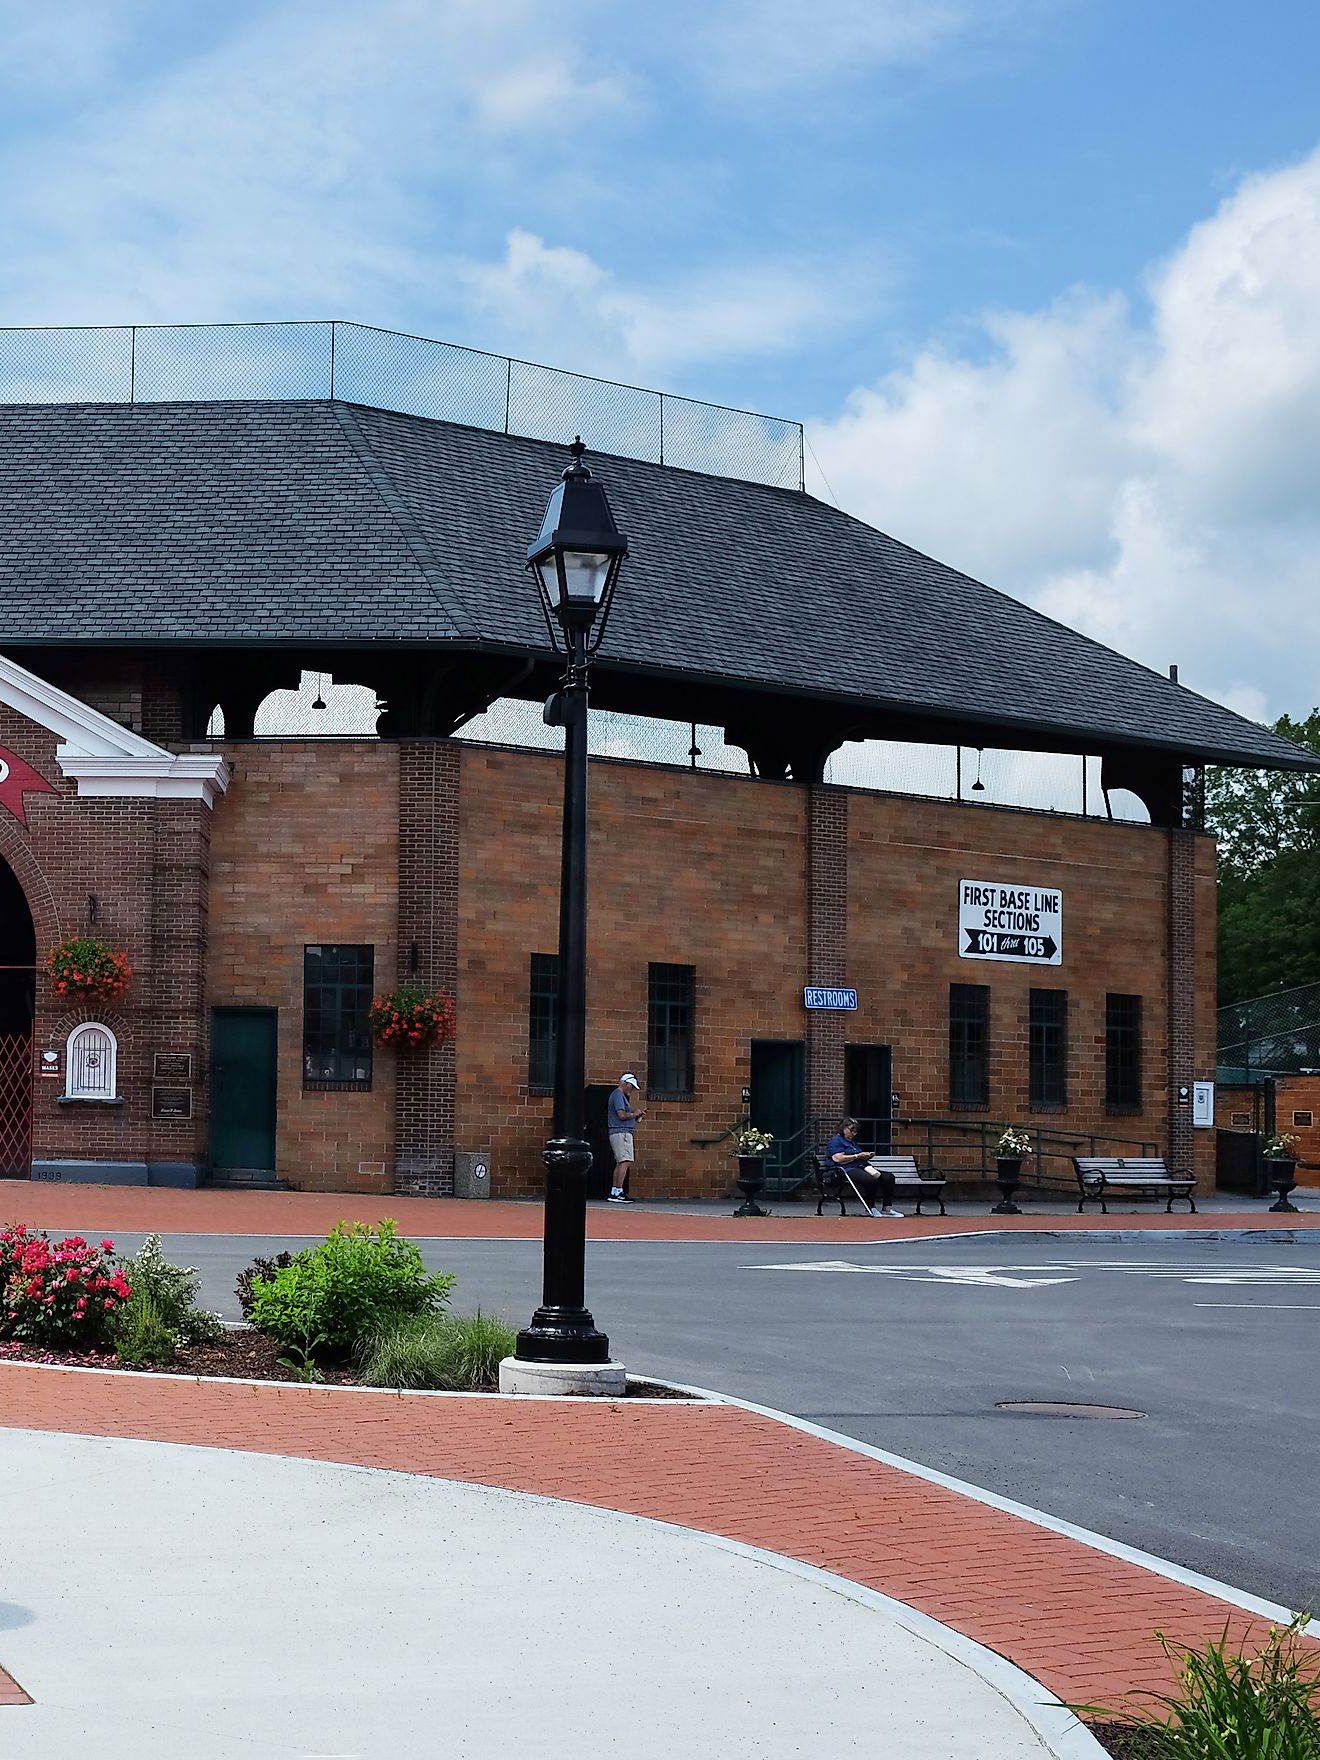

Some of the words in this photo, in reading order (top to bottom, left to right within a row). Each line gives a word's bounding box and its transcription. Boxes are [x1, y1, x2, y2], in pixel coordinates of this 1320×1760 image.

[963, 886, 996, 907] FIRST
[999, 890, 1031, 910] BASE
[1034, 893, 1059, 913] LINE
[983, 909, 1040, 932] SECTIONS
[978, 933, 998, 952] 101
[1023, 937, 1045, 956] 105
[807, 990, 855, 1007] RESTROOMS
